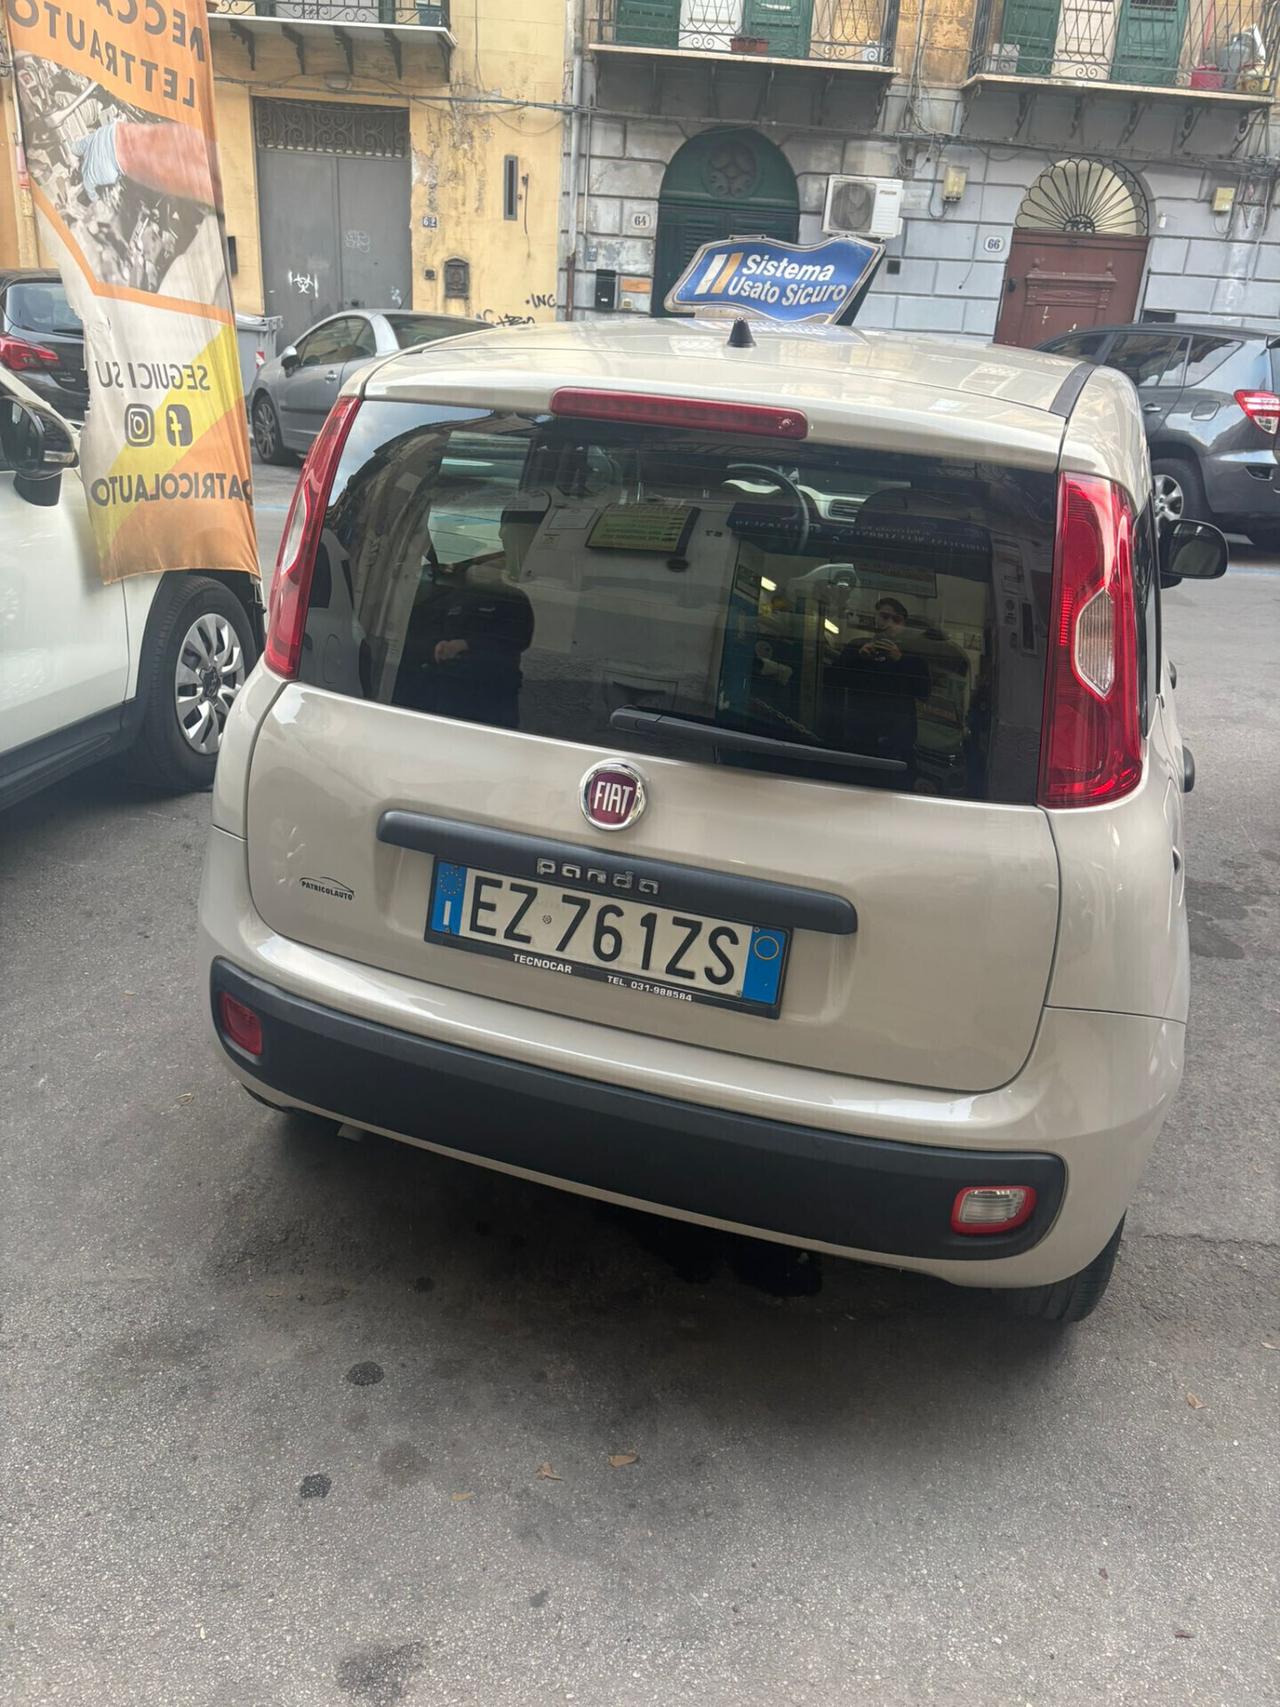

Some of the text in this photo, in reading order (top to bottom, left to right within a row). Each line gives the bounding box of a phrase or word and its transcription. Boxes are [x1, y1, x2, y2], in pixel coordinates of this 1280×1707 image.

[634, 215, 647, 226] 64
[987, 238, 1001, 250] 66
[742, 254, 836, 282] Sistema
[728, 276, 848, 307] Usato Sicuro
[593, 781, 634, 816] FIAT
[536, 857, 660, 895] panda
[301, 880, 353, 901] PATRICOLAUTO
[469, 875, 538, 944] EZ
[555, 894, 739, 986] 761ZS
[513, 953, 573, 975] TECNOCAR
[607, 975, 693, 1002] TEL. 031-988584
